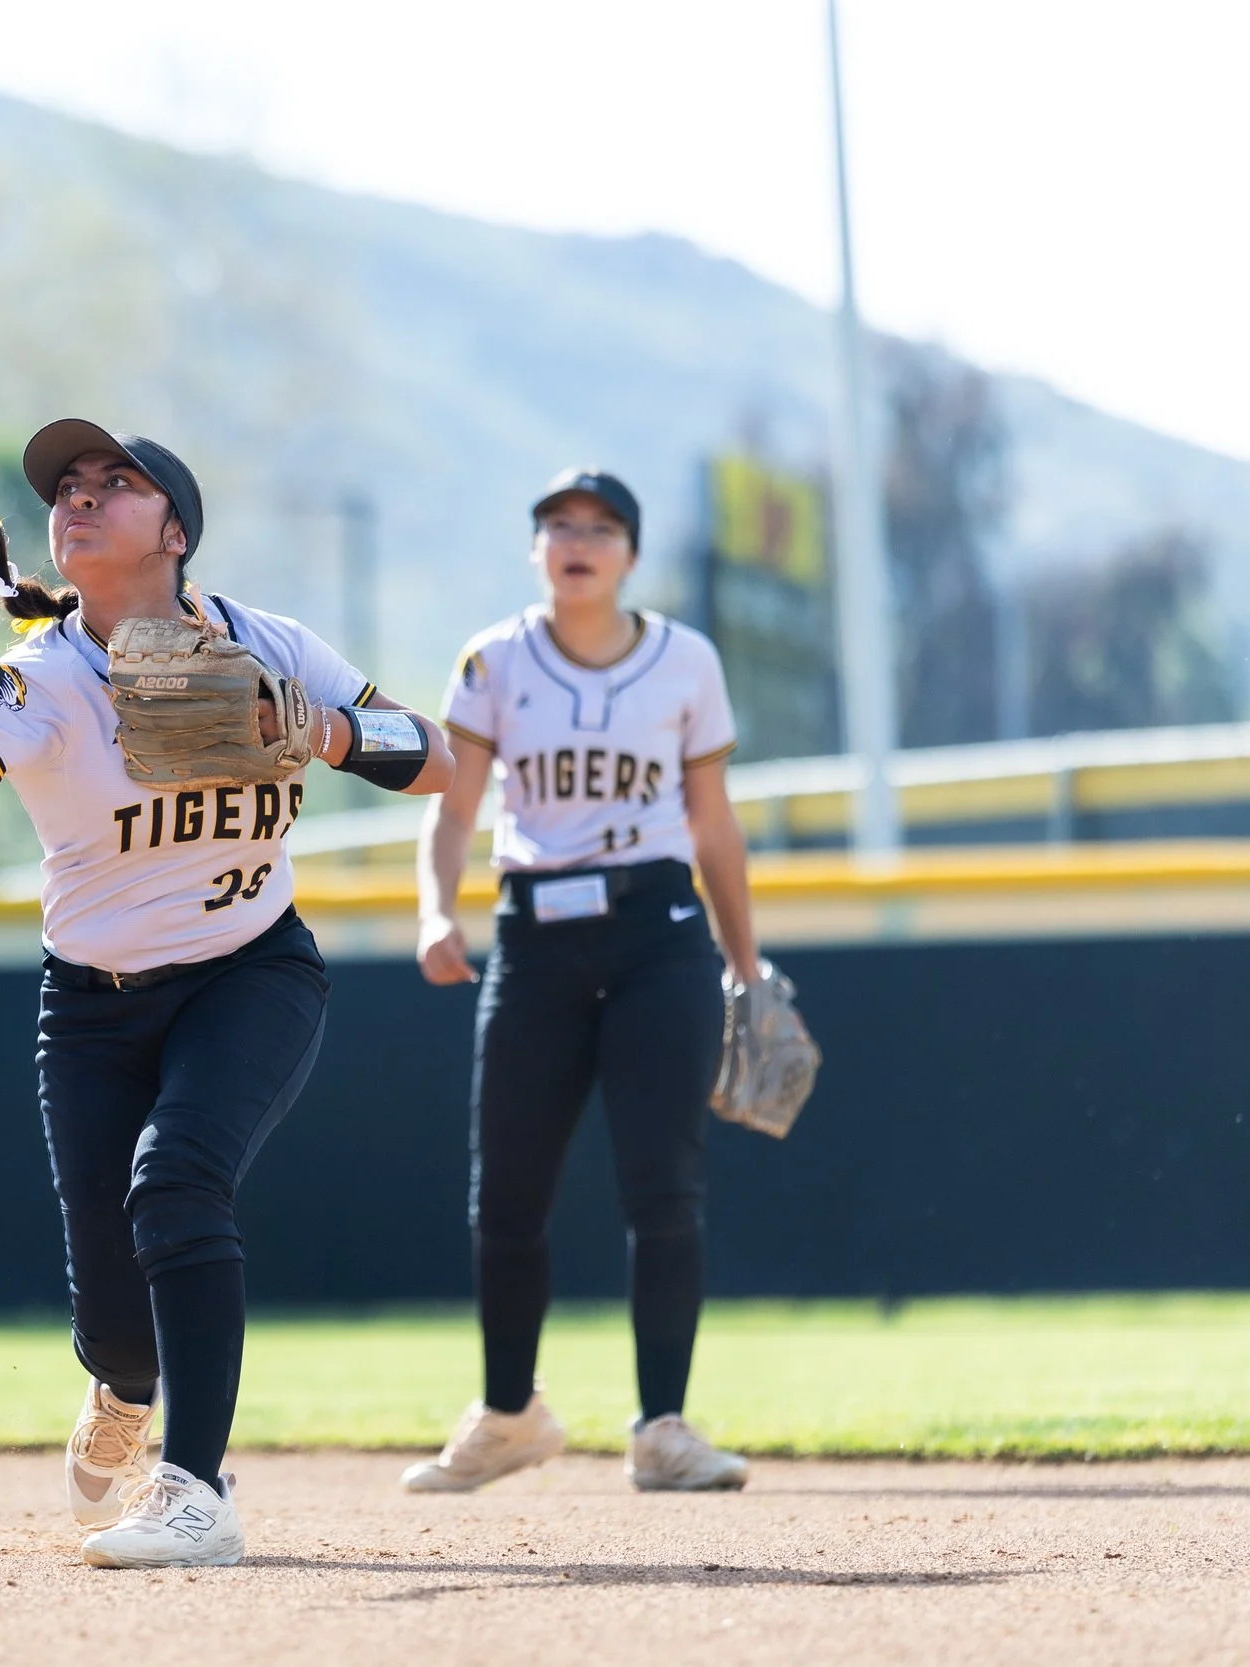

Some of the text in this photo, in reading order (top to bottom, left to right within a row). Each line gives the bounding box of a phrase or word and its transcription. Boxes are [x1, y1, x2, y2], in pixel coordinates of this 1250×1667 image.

[135, 676, 189, 690] A2000
[294, 688, 306, 725] Wilson
[515, 748, 662, 808] TIGERS
[114, 783, 303, 854] TIGERS
